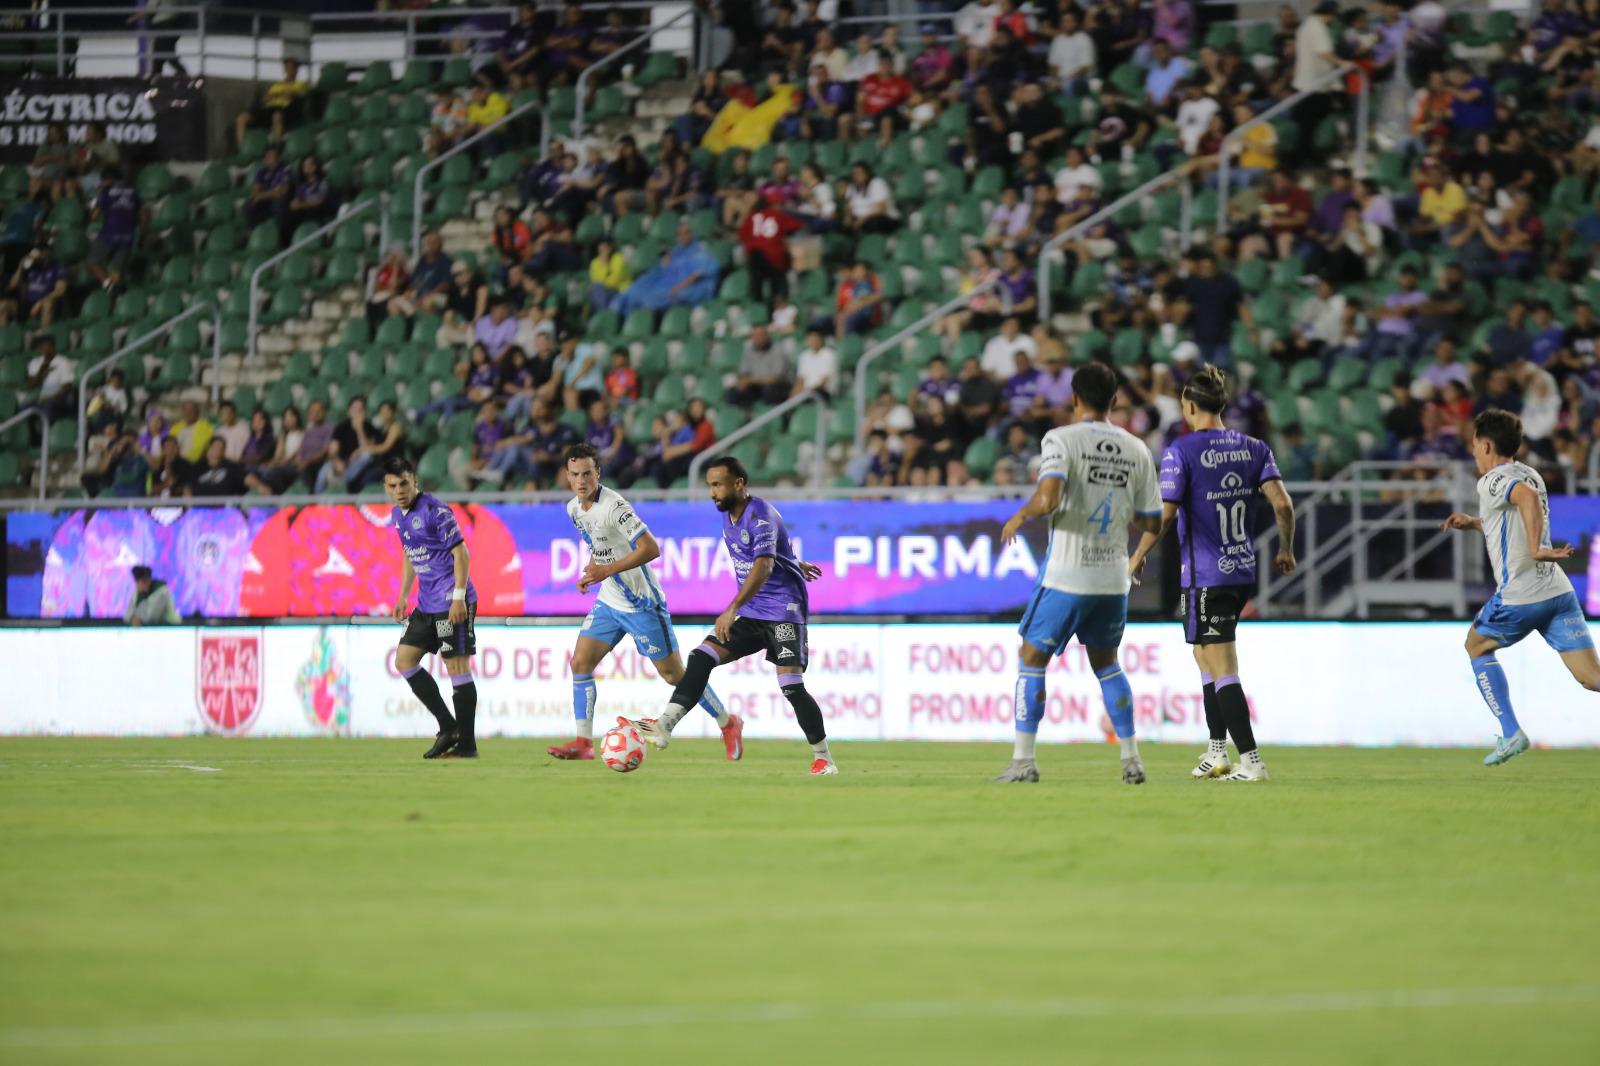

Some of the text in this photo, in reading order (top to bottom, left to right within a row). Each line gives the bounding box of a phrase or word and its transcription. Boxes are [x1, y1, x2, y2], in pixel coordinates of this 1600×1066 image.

[0, 88, 156, 121] ÉCTRICA
[1201, 448, 1252, 469] Corona
[1207, 490, 1231, 500] Banco
[1088, 498, 1113, 535] 4
[1216, 500, 1246, 545] 10
[833, 534, 1039, 580] PIRMA
[514, 648, 552, 680] DE
[909, 643, 1159, 673] FONDO DE
[1479, 671, 1503, 717] PERDURA
